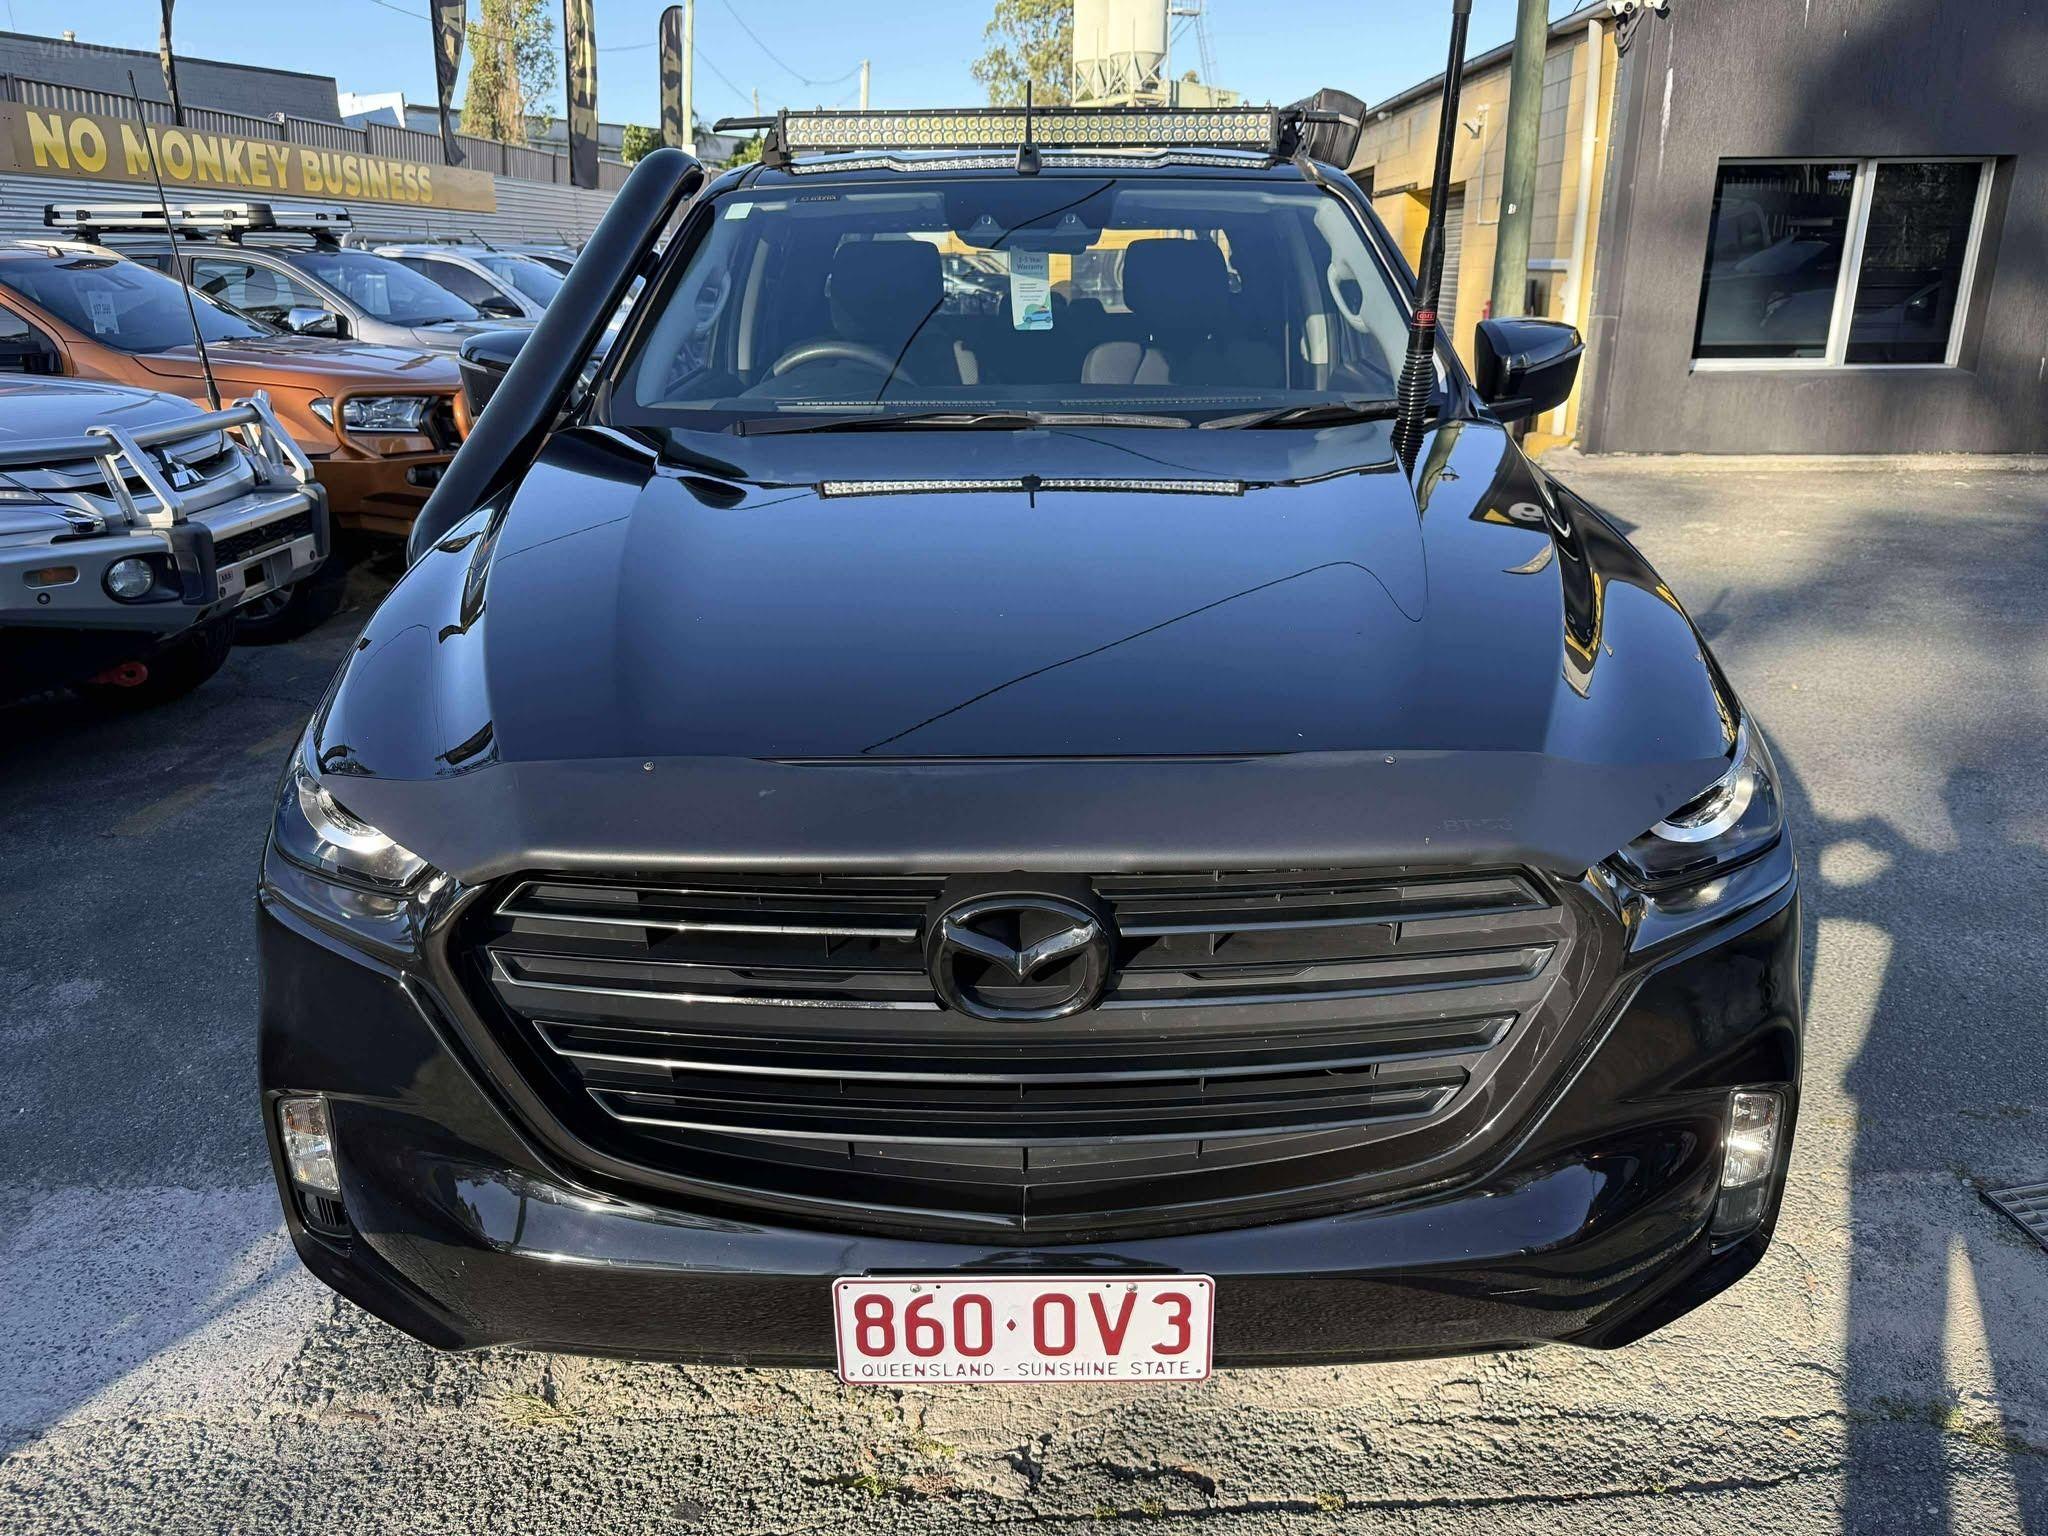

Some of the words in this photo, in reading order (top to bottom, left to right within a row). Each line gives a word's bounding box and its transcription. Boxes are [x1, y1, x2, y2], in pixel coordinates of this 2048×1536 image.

[26, 111, 107, 173] NO
[120, 124, 290, 189] MONKEY
[300, 149, 433, 204] BUSINESS
[1017, 263, 1043, 272] Warranty
[862, 1363, 994, 1377] QUEENSLAND
[1018, 1362, 1118, 1377] SUNSHINE
[1131, 1361, 1190, 1375] STATE
